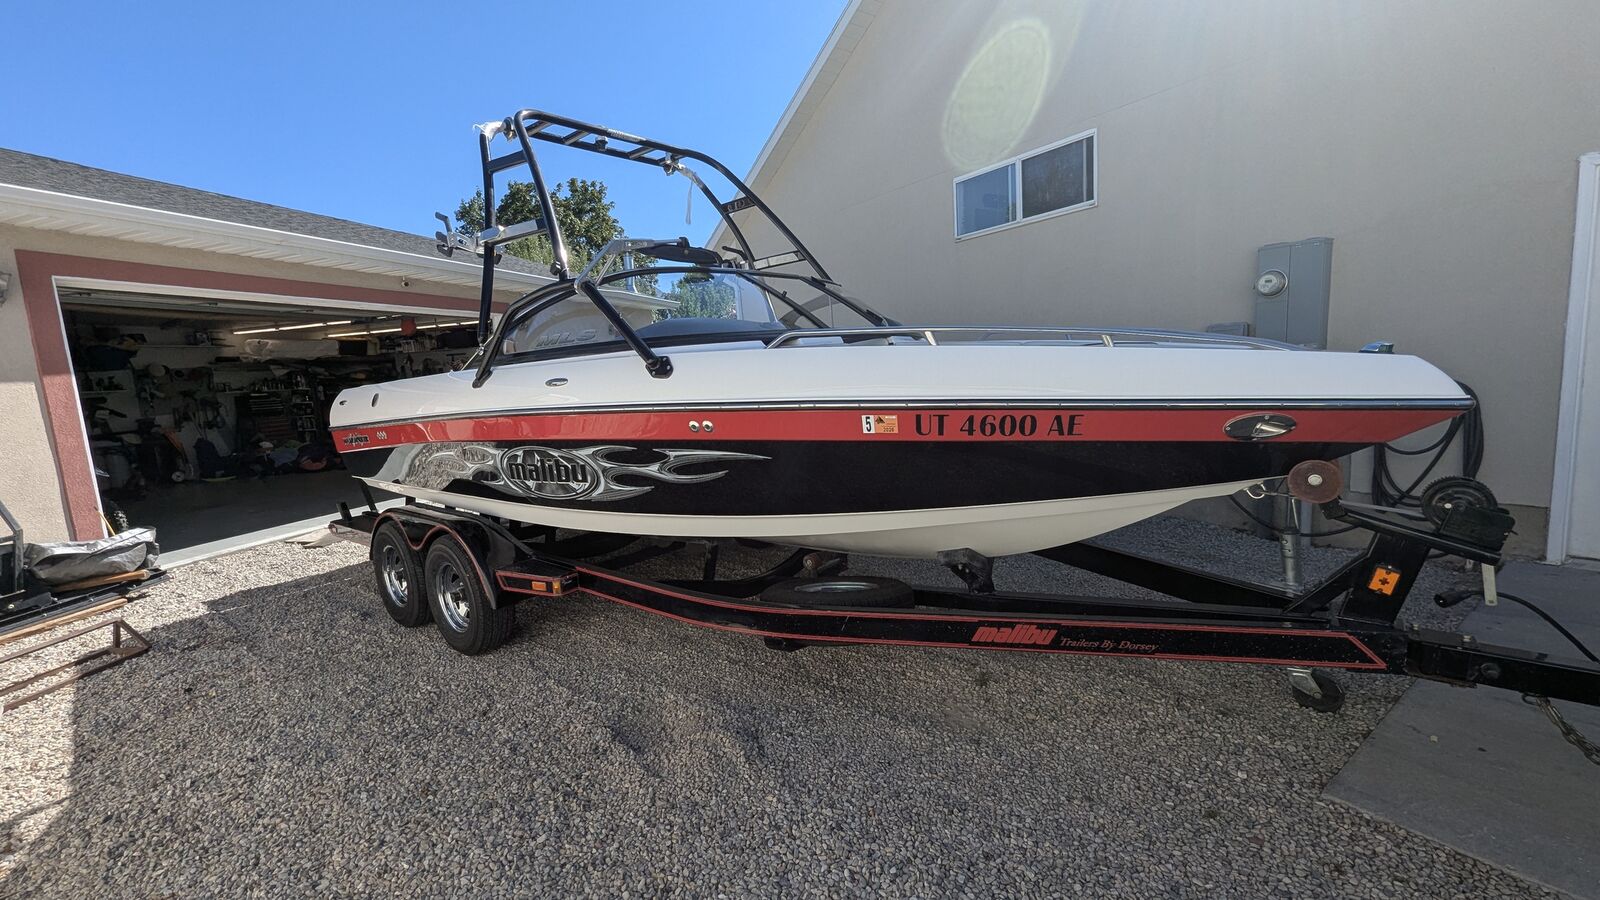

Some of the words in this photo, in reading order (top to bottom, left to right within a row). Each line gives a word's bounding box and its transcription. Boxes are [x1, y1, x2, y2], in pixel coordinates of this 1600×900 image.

[864, 416, 872, 432] 5
[915, 414, 949, 436] UT
[959, 414, 1037, 437] 4600
[1047, 414, 1084, 436] AE
[508, 457, 588, 483] malibu
[971, 624, 1058, 645] malibu
[1060, 637, 1098, 649] Trailers
[1101, 640, 1115, 650] By
[1119, 641, 1159, 653] Dorsey
